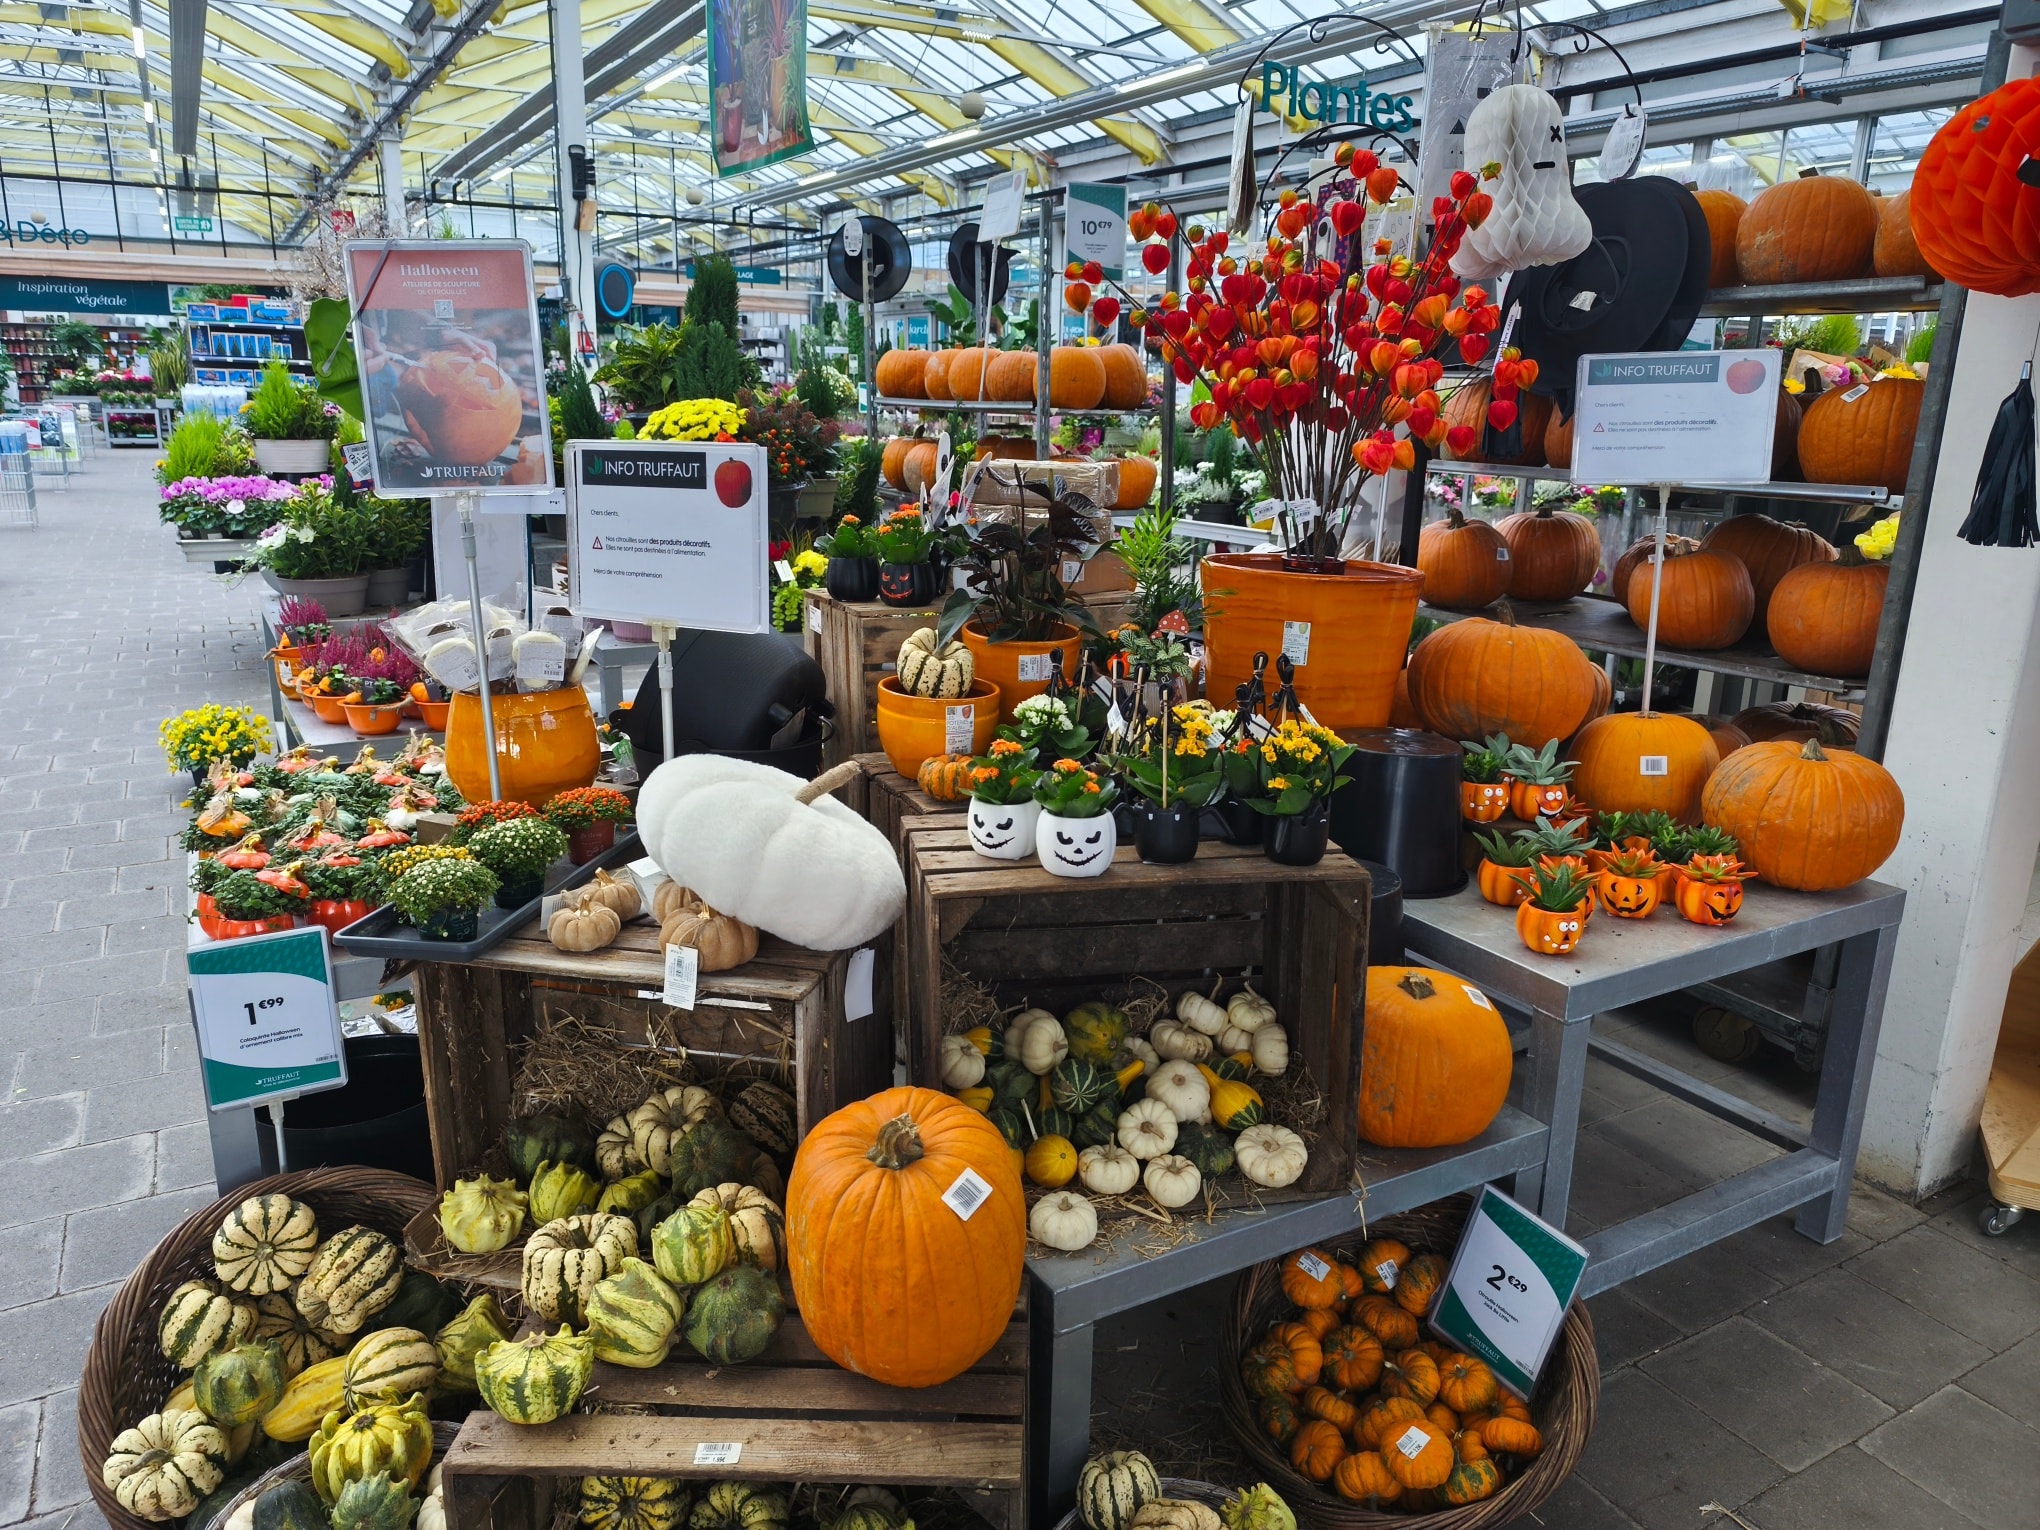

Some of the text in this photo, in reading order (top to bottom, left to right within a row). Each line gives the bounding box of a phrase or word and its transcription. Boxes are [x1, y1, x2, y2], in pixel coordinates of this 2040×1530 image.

[1261, 60, 1413, 133] Plantes
[17, 221, 90, 245] Déco
[400, 264, 479, 276] Halloween
[17, 281, 89, 295] Inspiration
[75, 294, 127, 308] végétale
[1613, 363, 1713, 377] INFO TRUFFAUT
[433, 465, 506, 478] TRUFFAUT
[605, 460, 700, 478] INFO TRUFFAUT
[615, 536, 638, 544] citrouilles
[660, 538, 682, 547] produits
[239, 1026, 301, 1044] Coloquinte Halloween
[239, 1038, 273, 1050] d'ornement
[273, 1034, 293, 1043] calibre
[261, 1070, 301, 1085] TRUFFAUT
